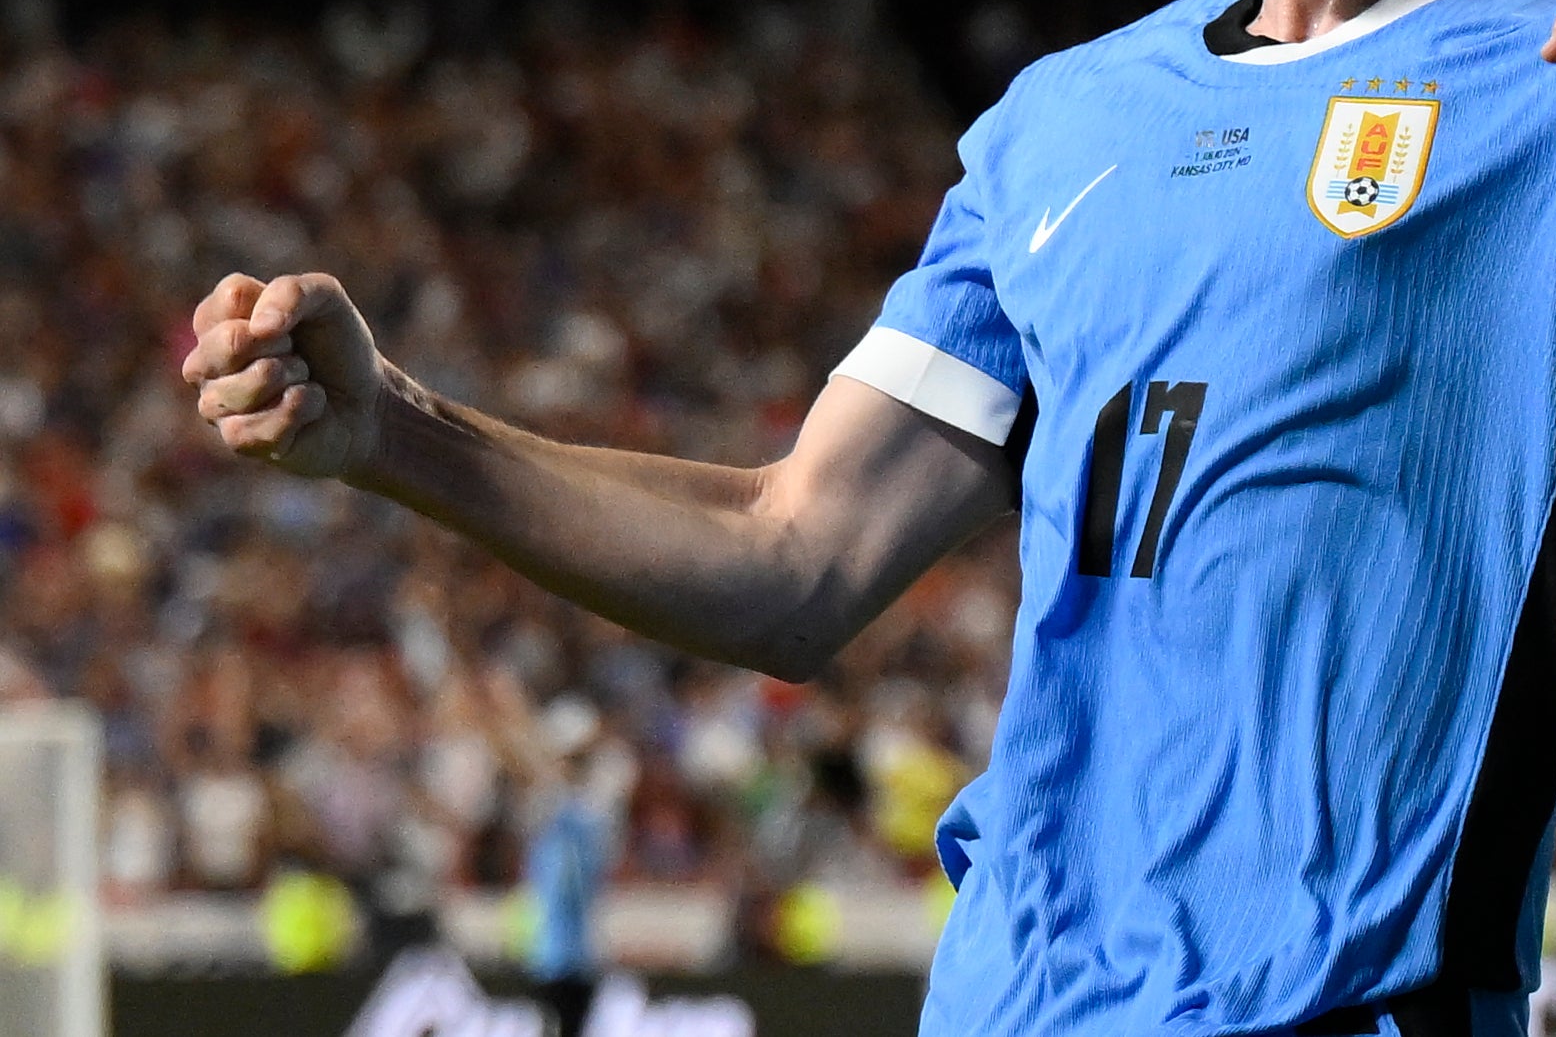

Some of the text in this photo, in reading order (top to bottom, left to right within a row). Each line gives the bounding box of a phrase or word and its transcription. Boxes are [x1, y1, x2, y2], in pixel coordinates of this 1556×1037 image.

[1222, 127, 1249, 145] USA
[1356, 122, 1388, 171] AUF
[1171, 163, 1212, 178] KANSAS
[1235, 155, 1251, 168] MO
[1078, 379, 1209, 579] 17
